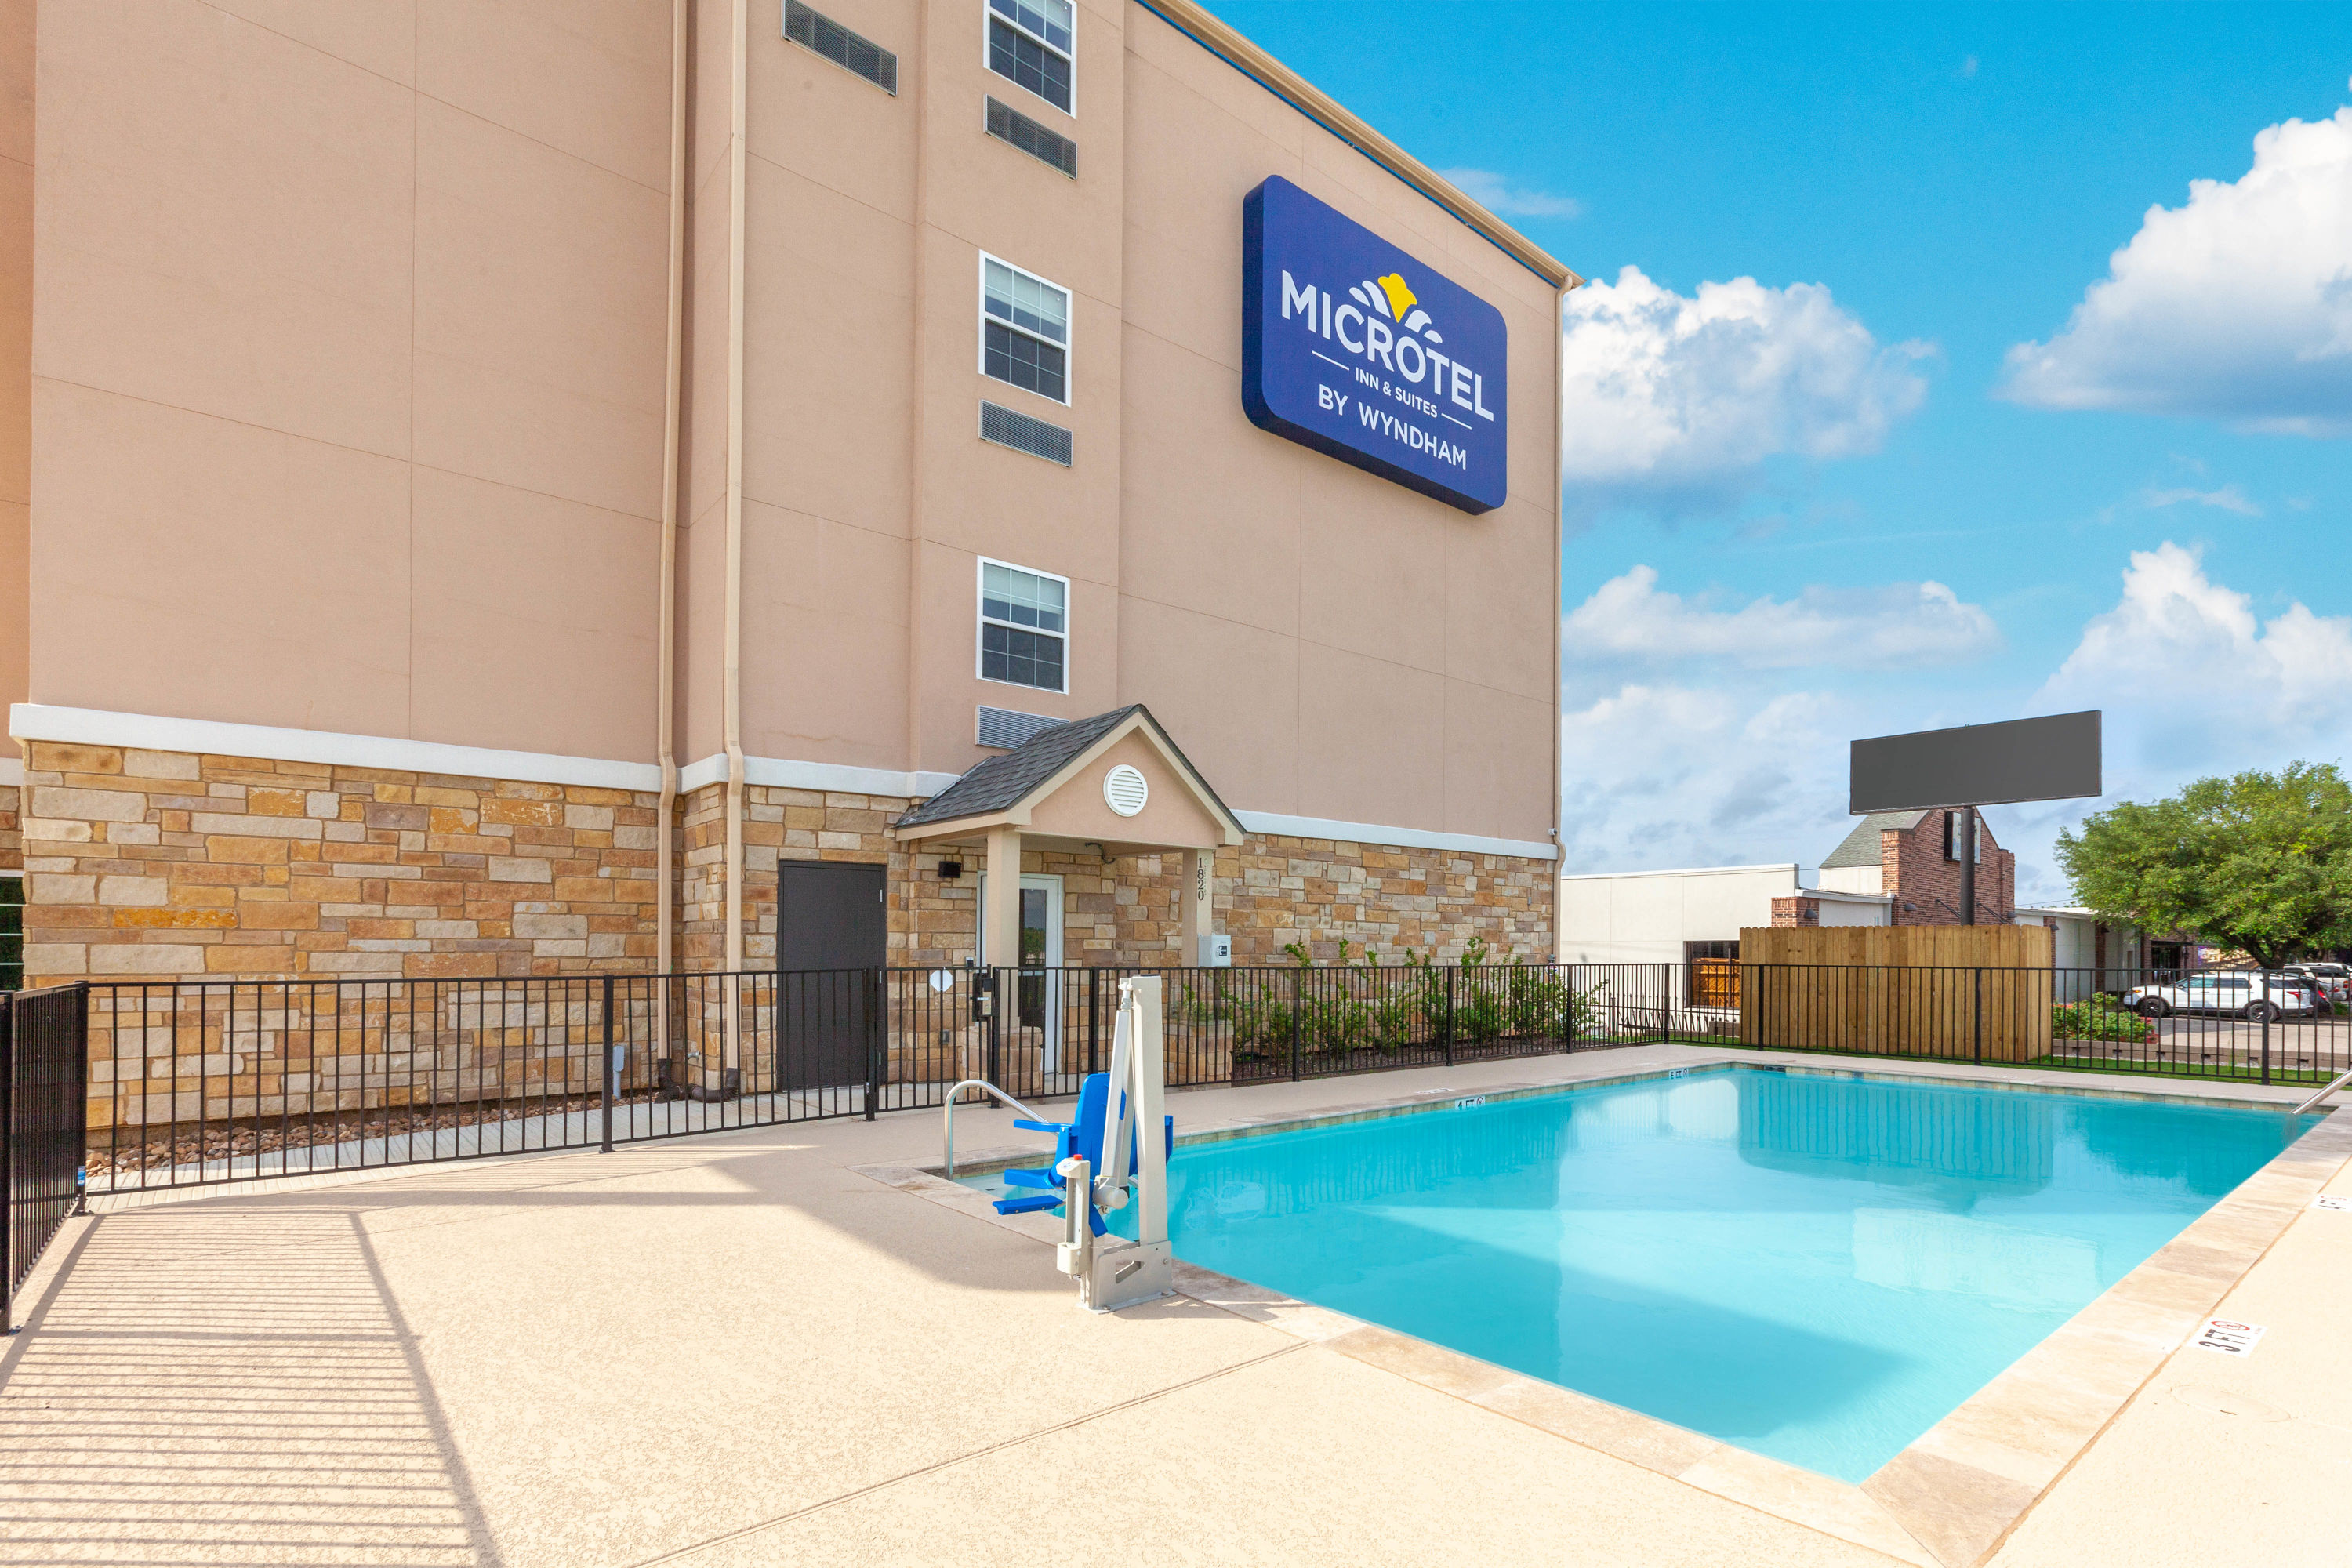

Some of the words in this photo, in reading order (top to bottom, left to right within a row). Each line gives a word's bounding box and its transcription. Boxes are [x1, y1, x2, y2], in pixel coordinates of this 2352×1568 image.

[1281, 269, 1494, 422] MICROTEL
[1356, 367, 1379, 391] INN
[1383, 381, 1392, 397] &
[1395, 387, 1438, 419] SUITES
[1319, 383, 1348, 416] BY
[1358, 401, 1467, 470] WYNDHAM
[2198, 1341, 2241, 1352] 3
[2204, 1328, 2251, 1345] FT
